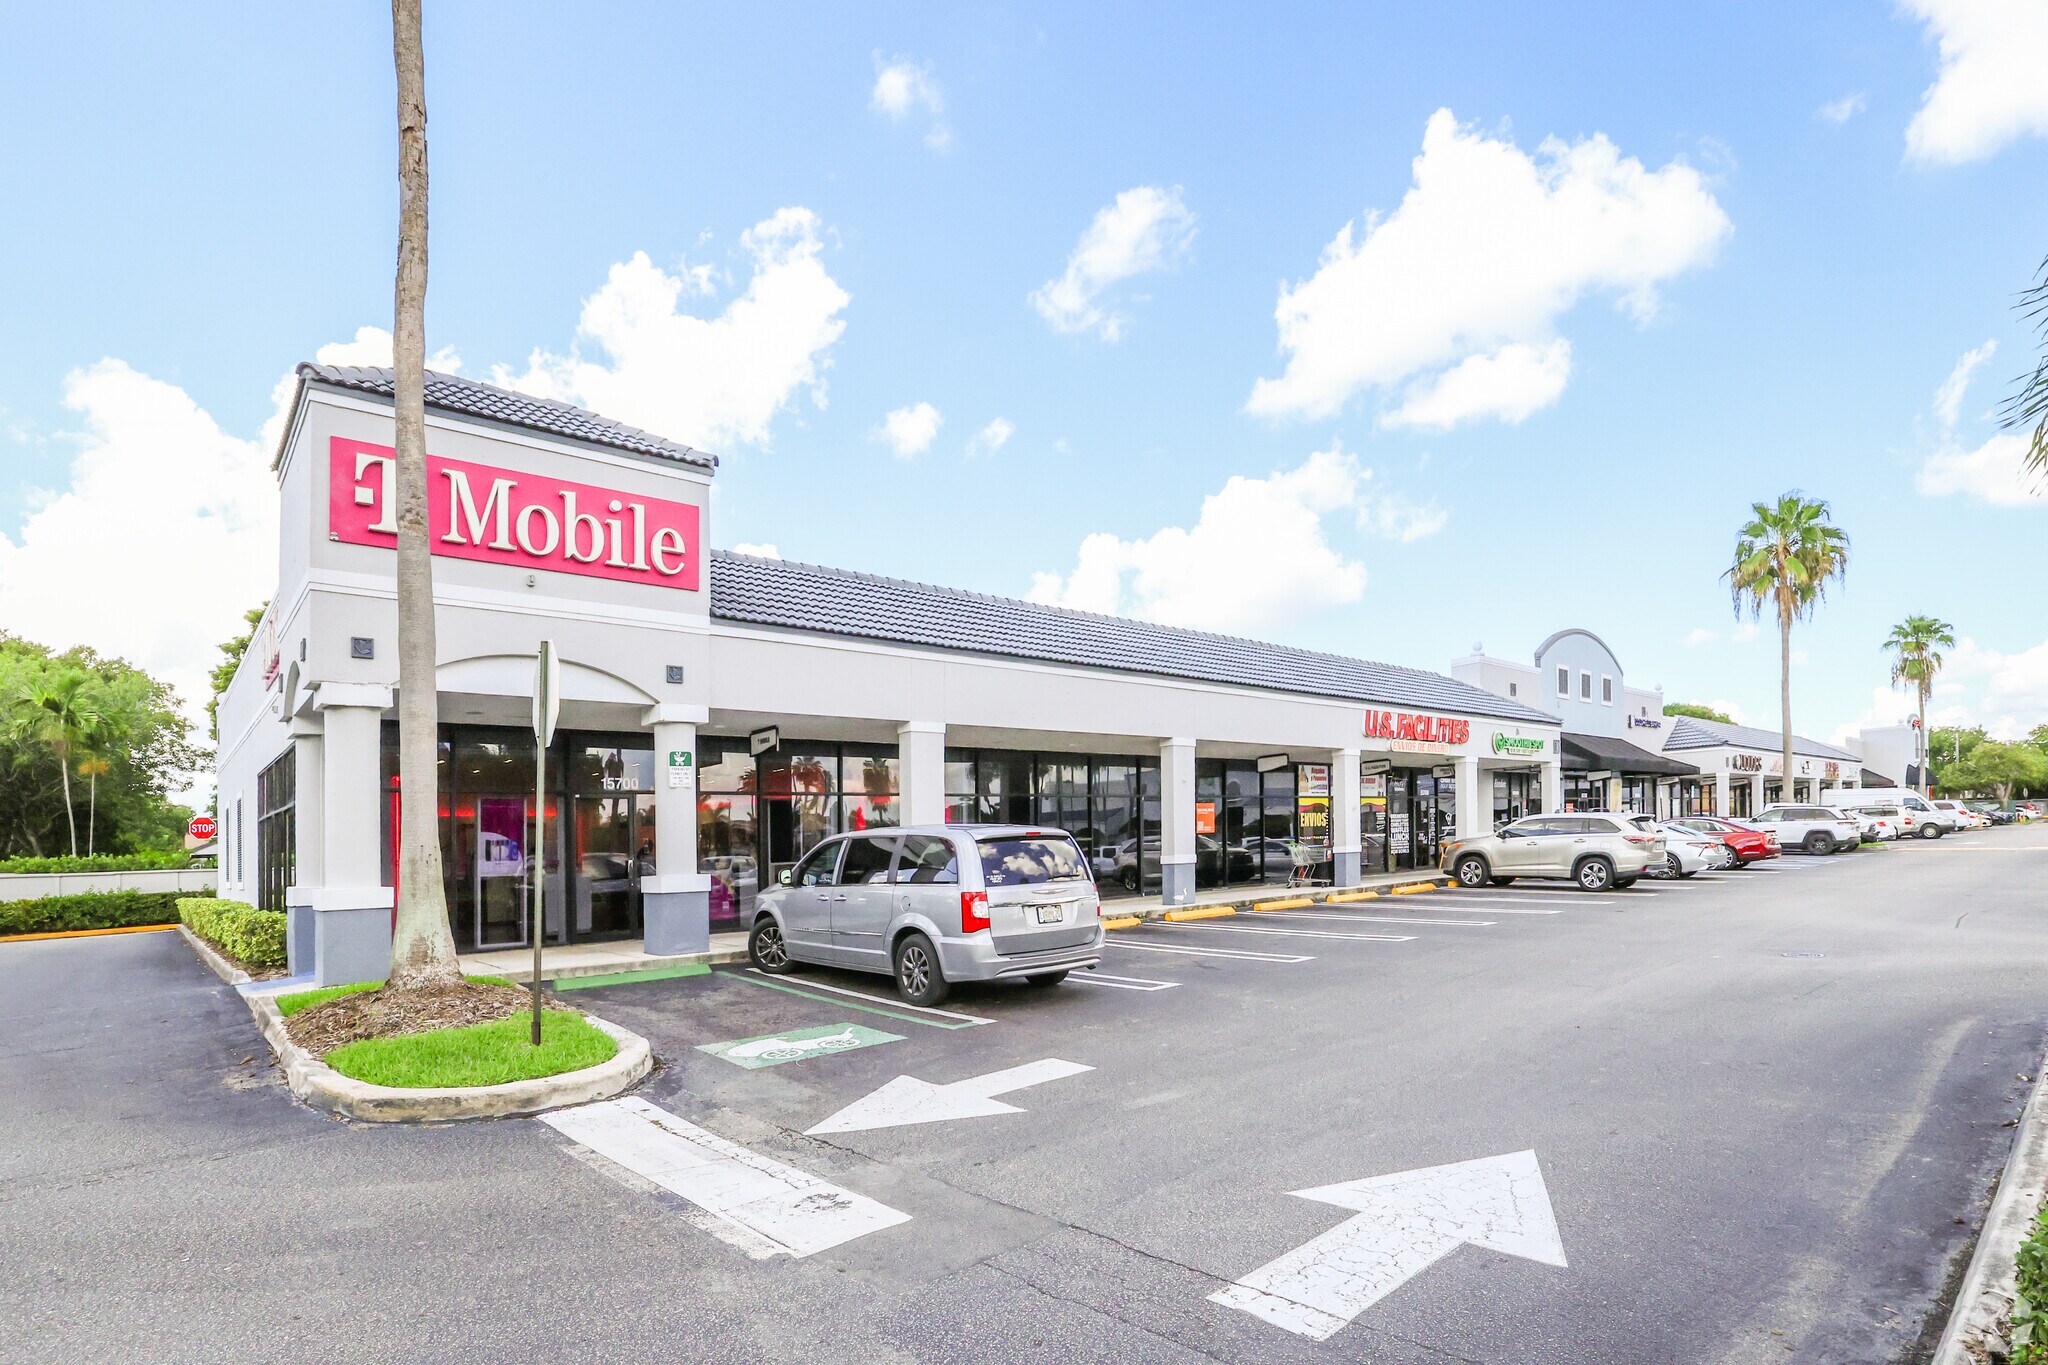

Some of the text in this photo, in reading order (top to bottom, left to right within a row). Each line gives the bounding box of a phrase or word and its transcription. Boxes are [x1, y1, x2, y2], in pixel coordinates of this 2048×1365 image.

[441, 468, 686, 576] Mobile
[1365, 710, 1470, 744] U.S. FACILITIES
[1393, 741, 1449, 753] ENVIOS DE DINERO
[601, 777, 639, 789] 15700
[1300, 812, 1327, 827] ENVIOS
[191, 823, 215, 833] STOP
[1390, 832, 1410, 841] LUNCH
